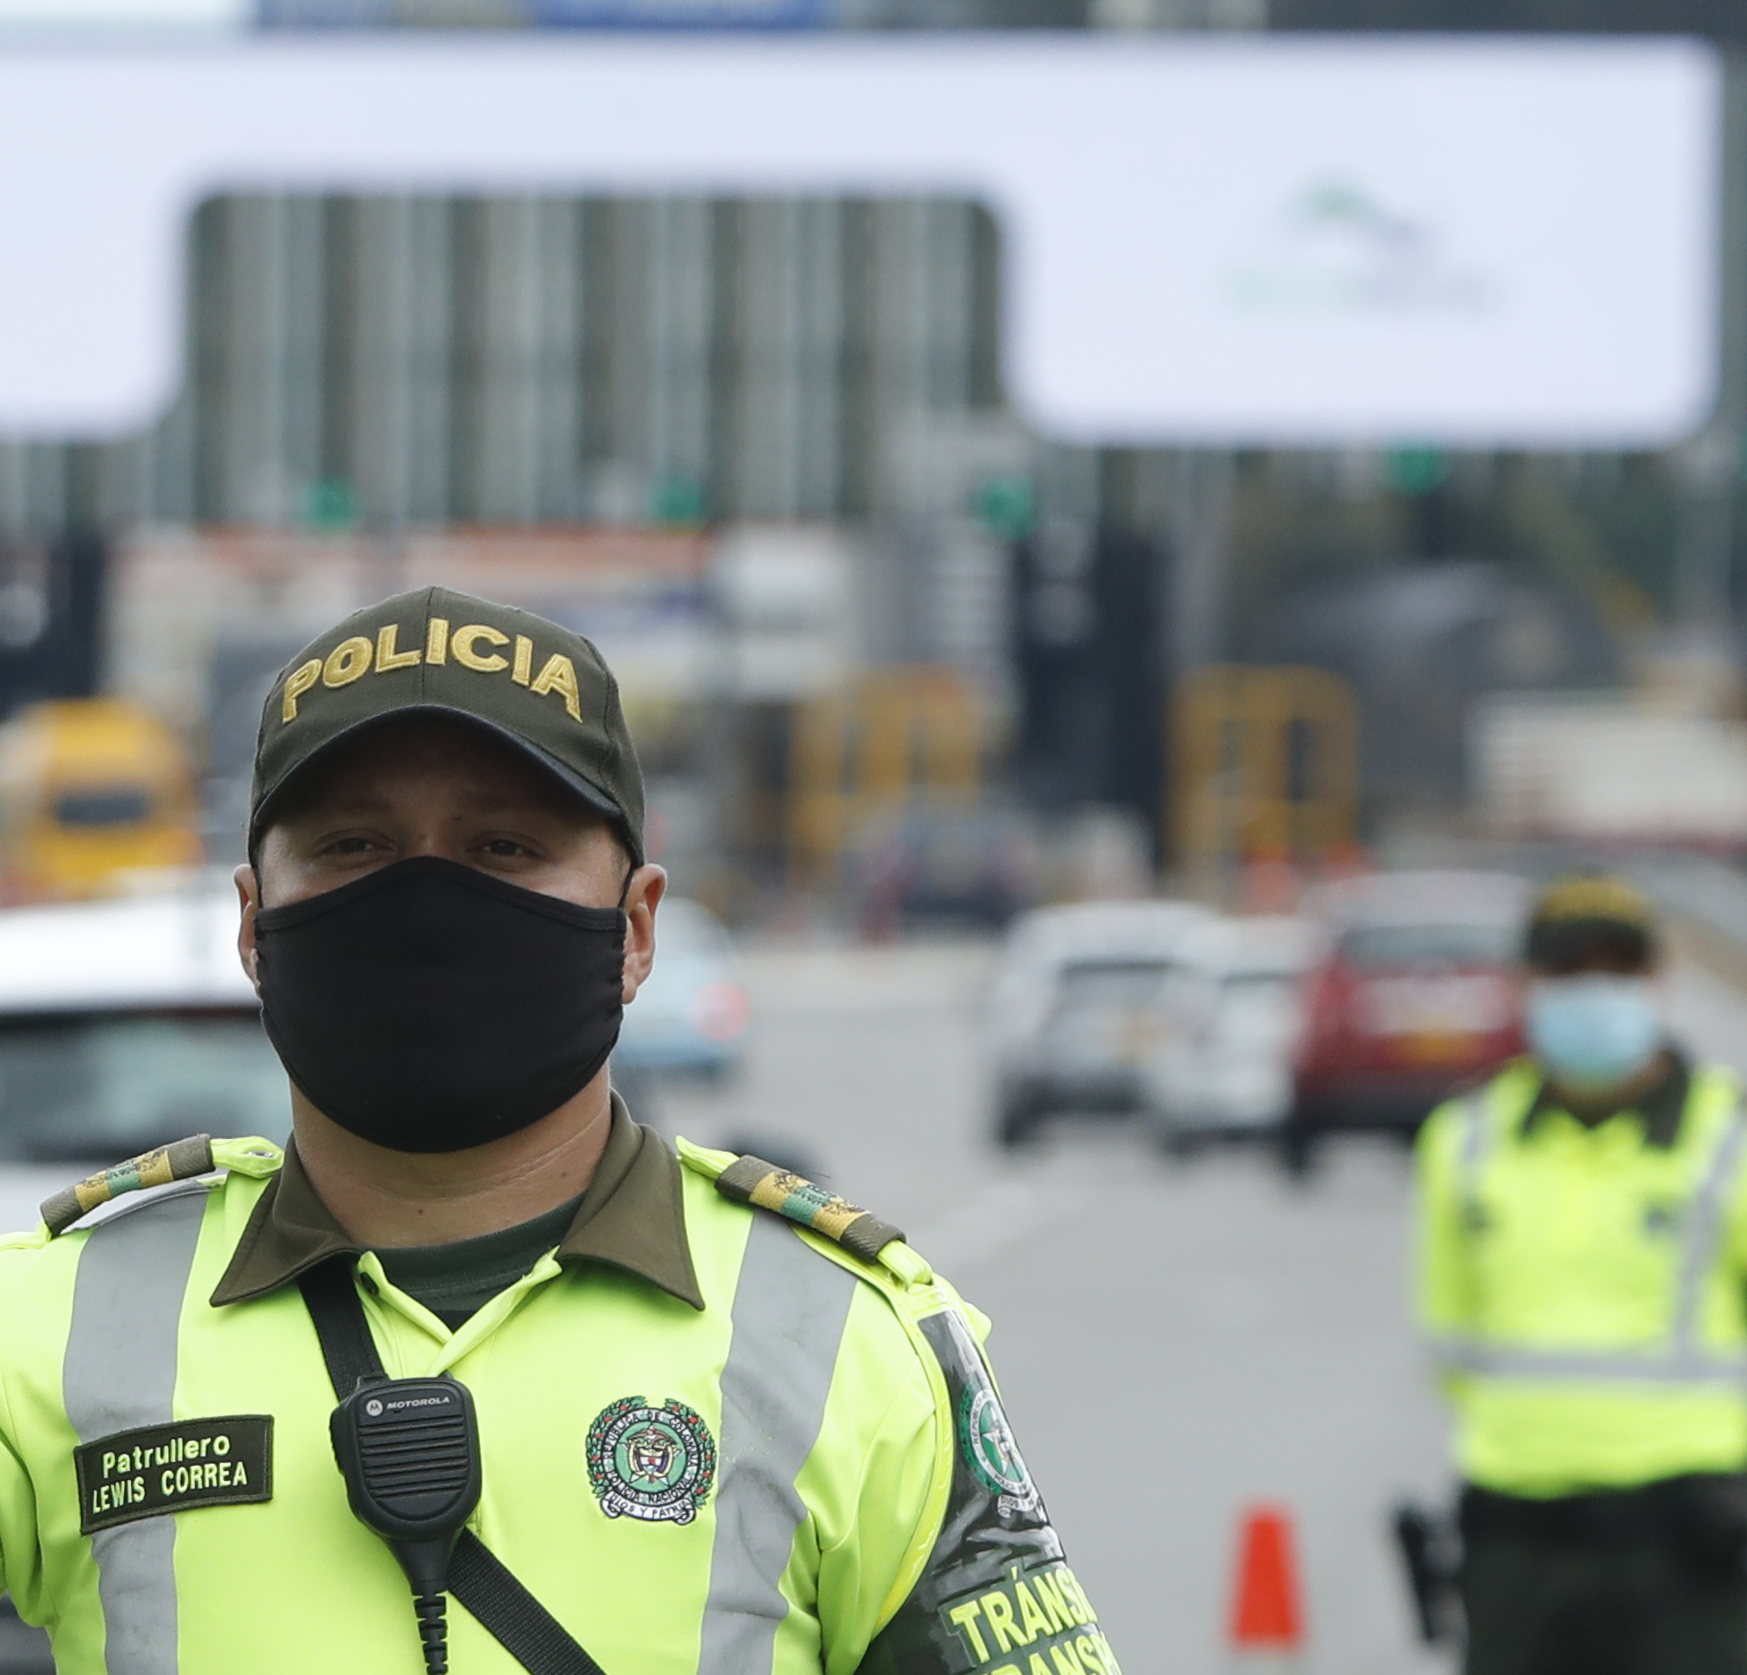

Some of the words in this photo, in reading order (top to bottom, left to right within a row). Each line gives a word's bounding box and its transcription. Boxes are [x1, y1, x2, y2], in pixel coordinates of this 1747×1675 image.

[282, 617, 584, 724] POLICIA
[386, 1396, 451, 1410] MOTOROLA
[102, 1434, 231, 1479] Patrullero
[91, 1476, 146, 1515] LEWIS
[161, 1461, 248, 1497] CORREA
